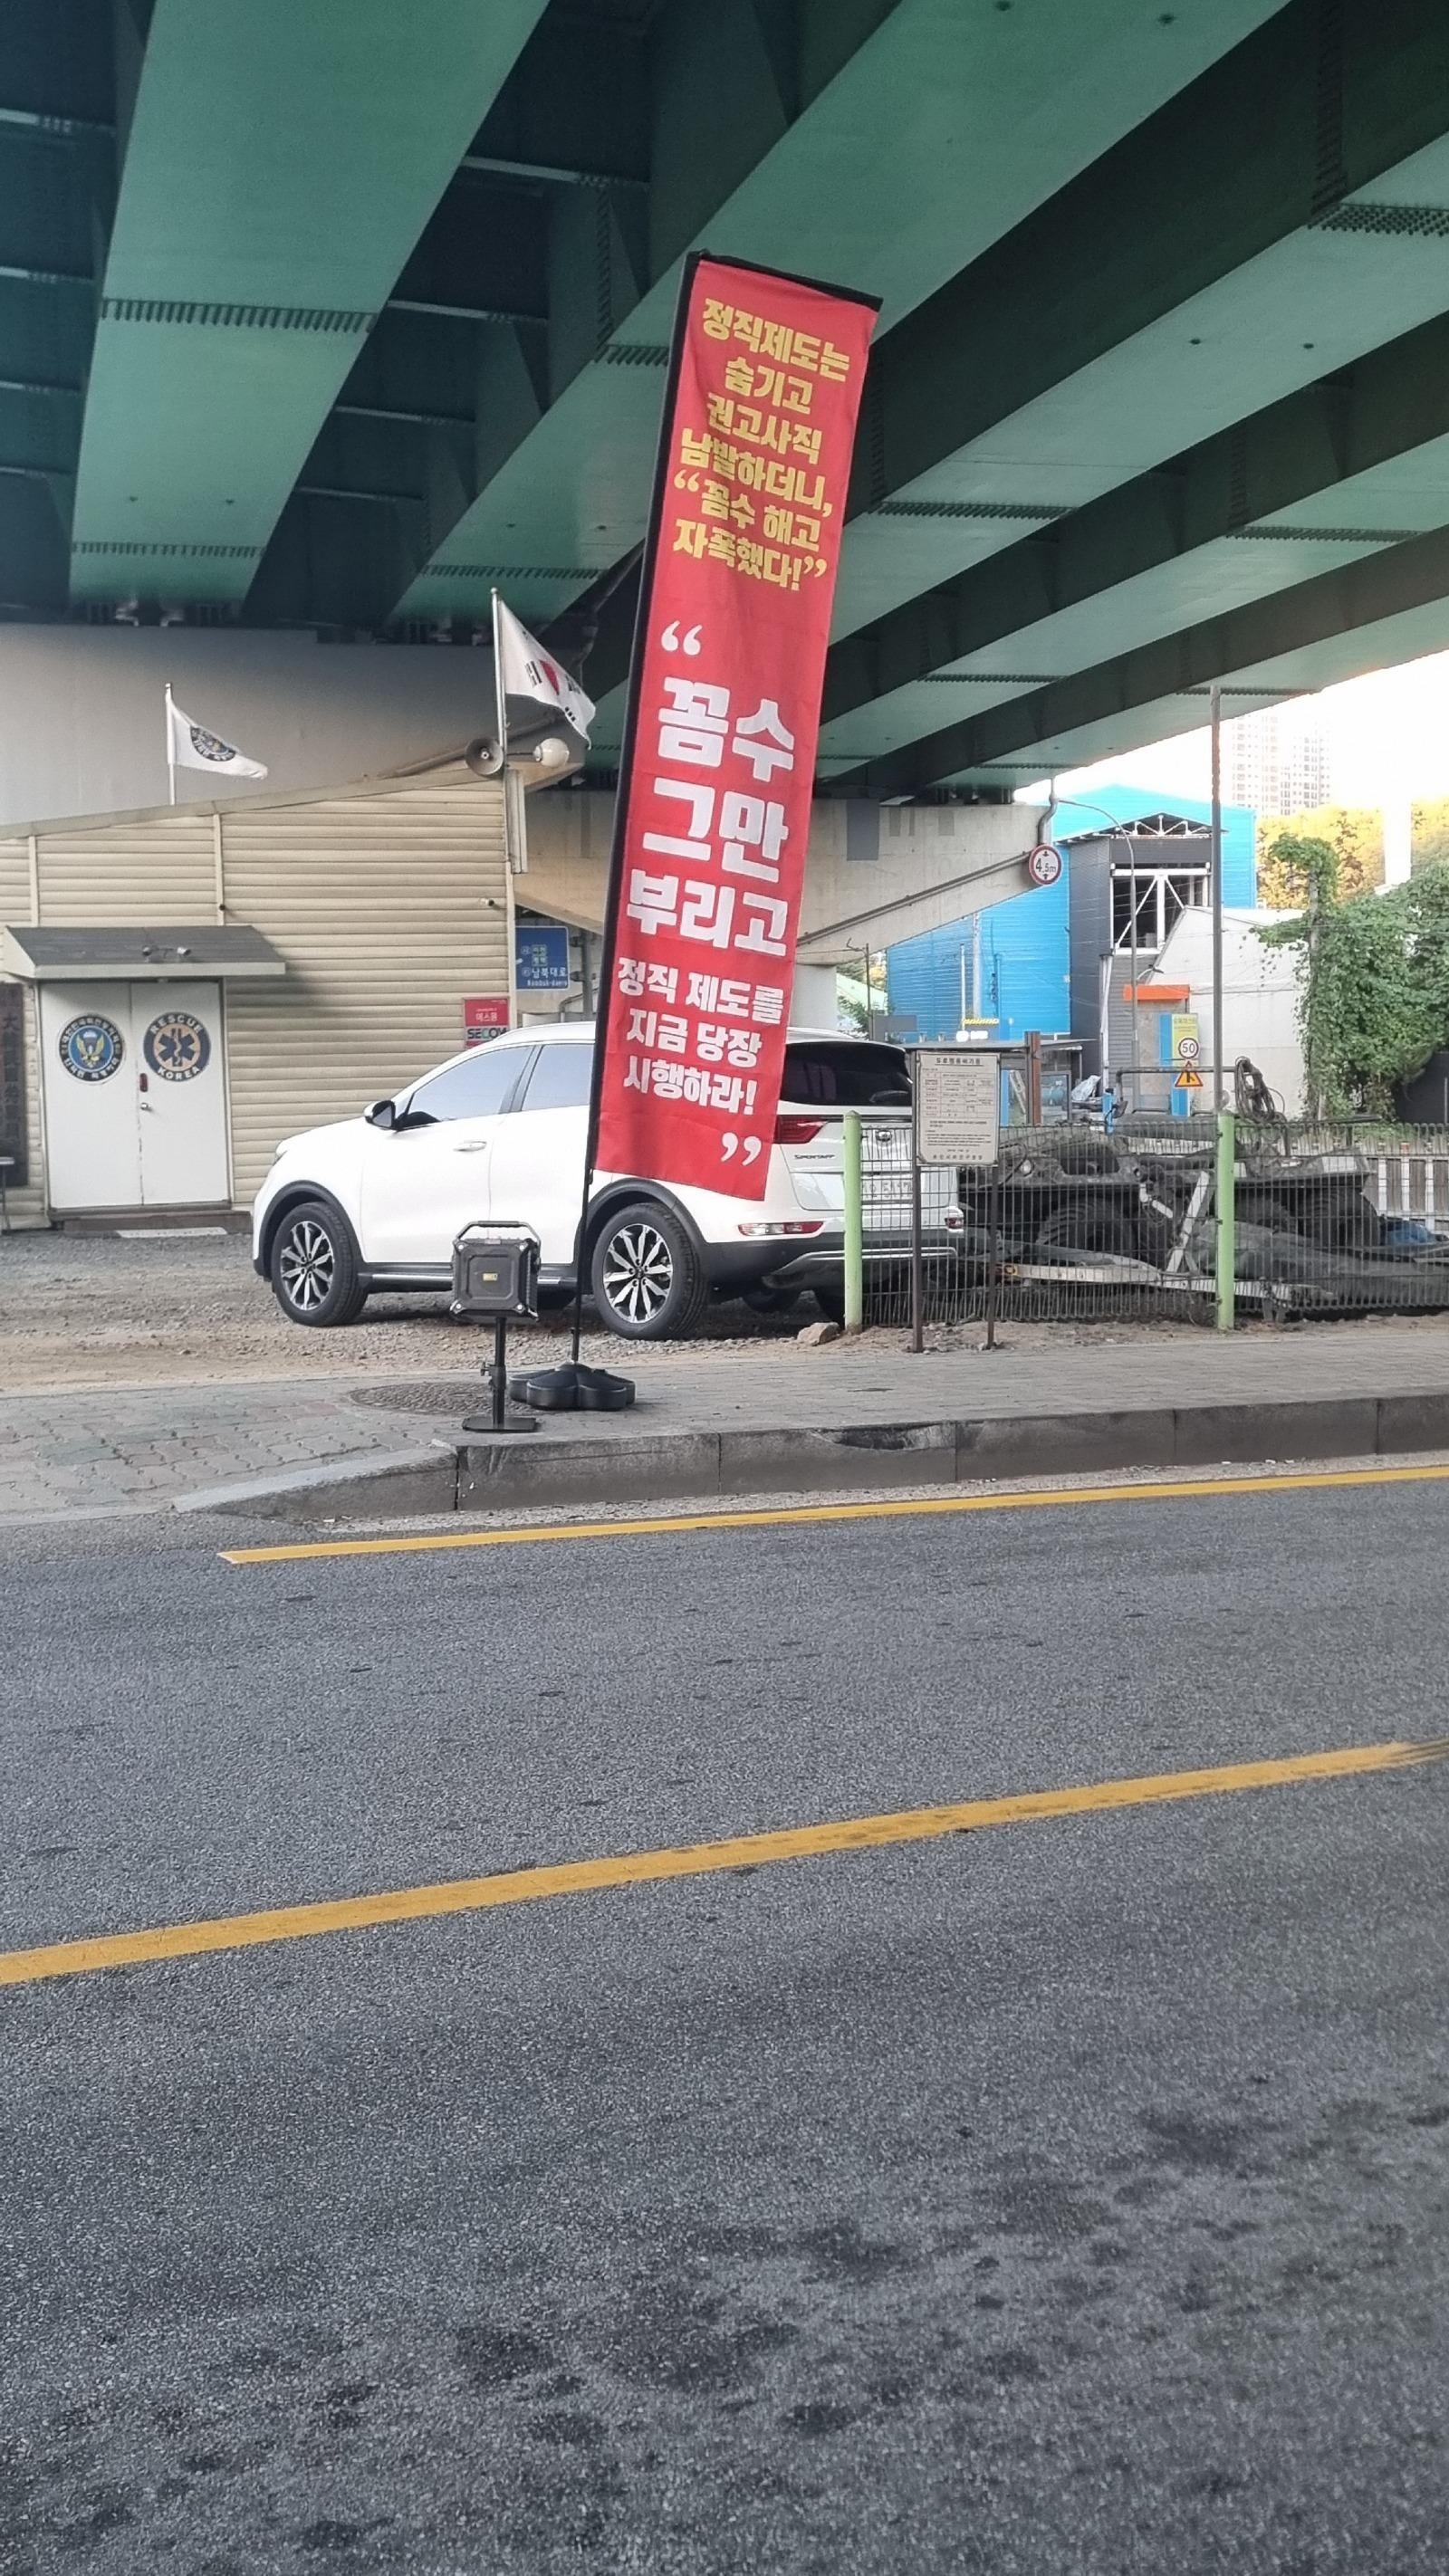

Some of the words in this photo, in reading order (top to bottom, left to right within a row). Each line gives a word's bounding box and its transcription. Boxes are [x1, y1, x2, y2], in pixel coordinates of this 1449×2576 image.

[703, 298, 849, 382] 정직제도는
[724, 357, 812, 415] 숨기고
[707, 392, 822, 464] 권고사직
[681, 428, 833, 518] 남발하더니,
[763, 505, 820, 551] 해고
[658, 676, 794, 782] 꼼수
[642, 777, 789, 883] 그만
[1036, 858, 1056, 872] 4.5m
[627, 868, 788, 956] 부리고
[532, 967, 566, 979] 남북대로
[618, 957, 679, 1004] 정직
[685, 972, 784, 1025] 제도를
[150, 1014, 203, 1033] RESCUE
[626, 1008, 688, 1054] 지금
[696, 1022, 762, 1068] 당장
[1182, 1043, 1195, 1053] 50
[158, 1067, 199, 1079] KOREA
[623, 1055, 757, 1116] 시행하라!
